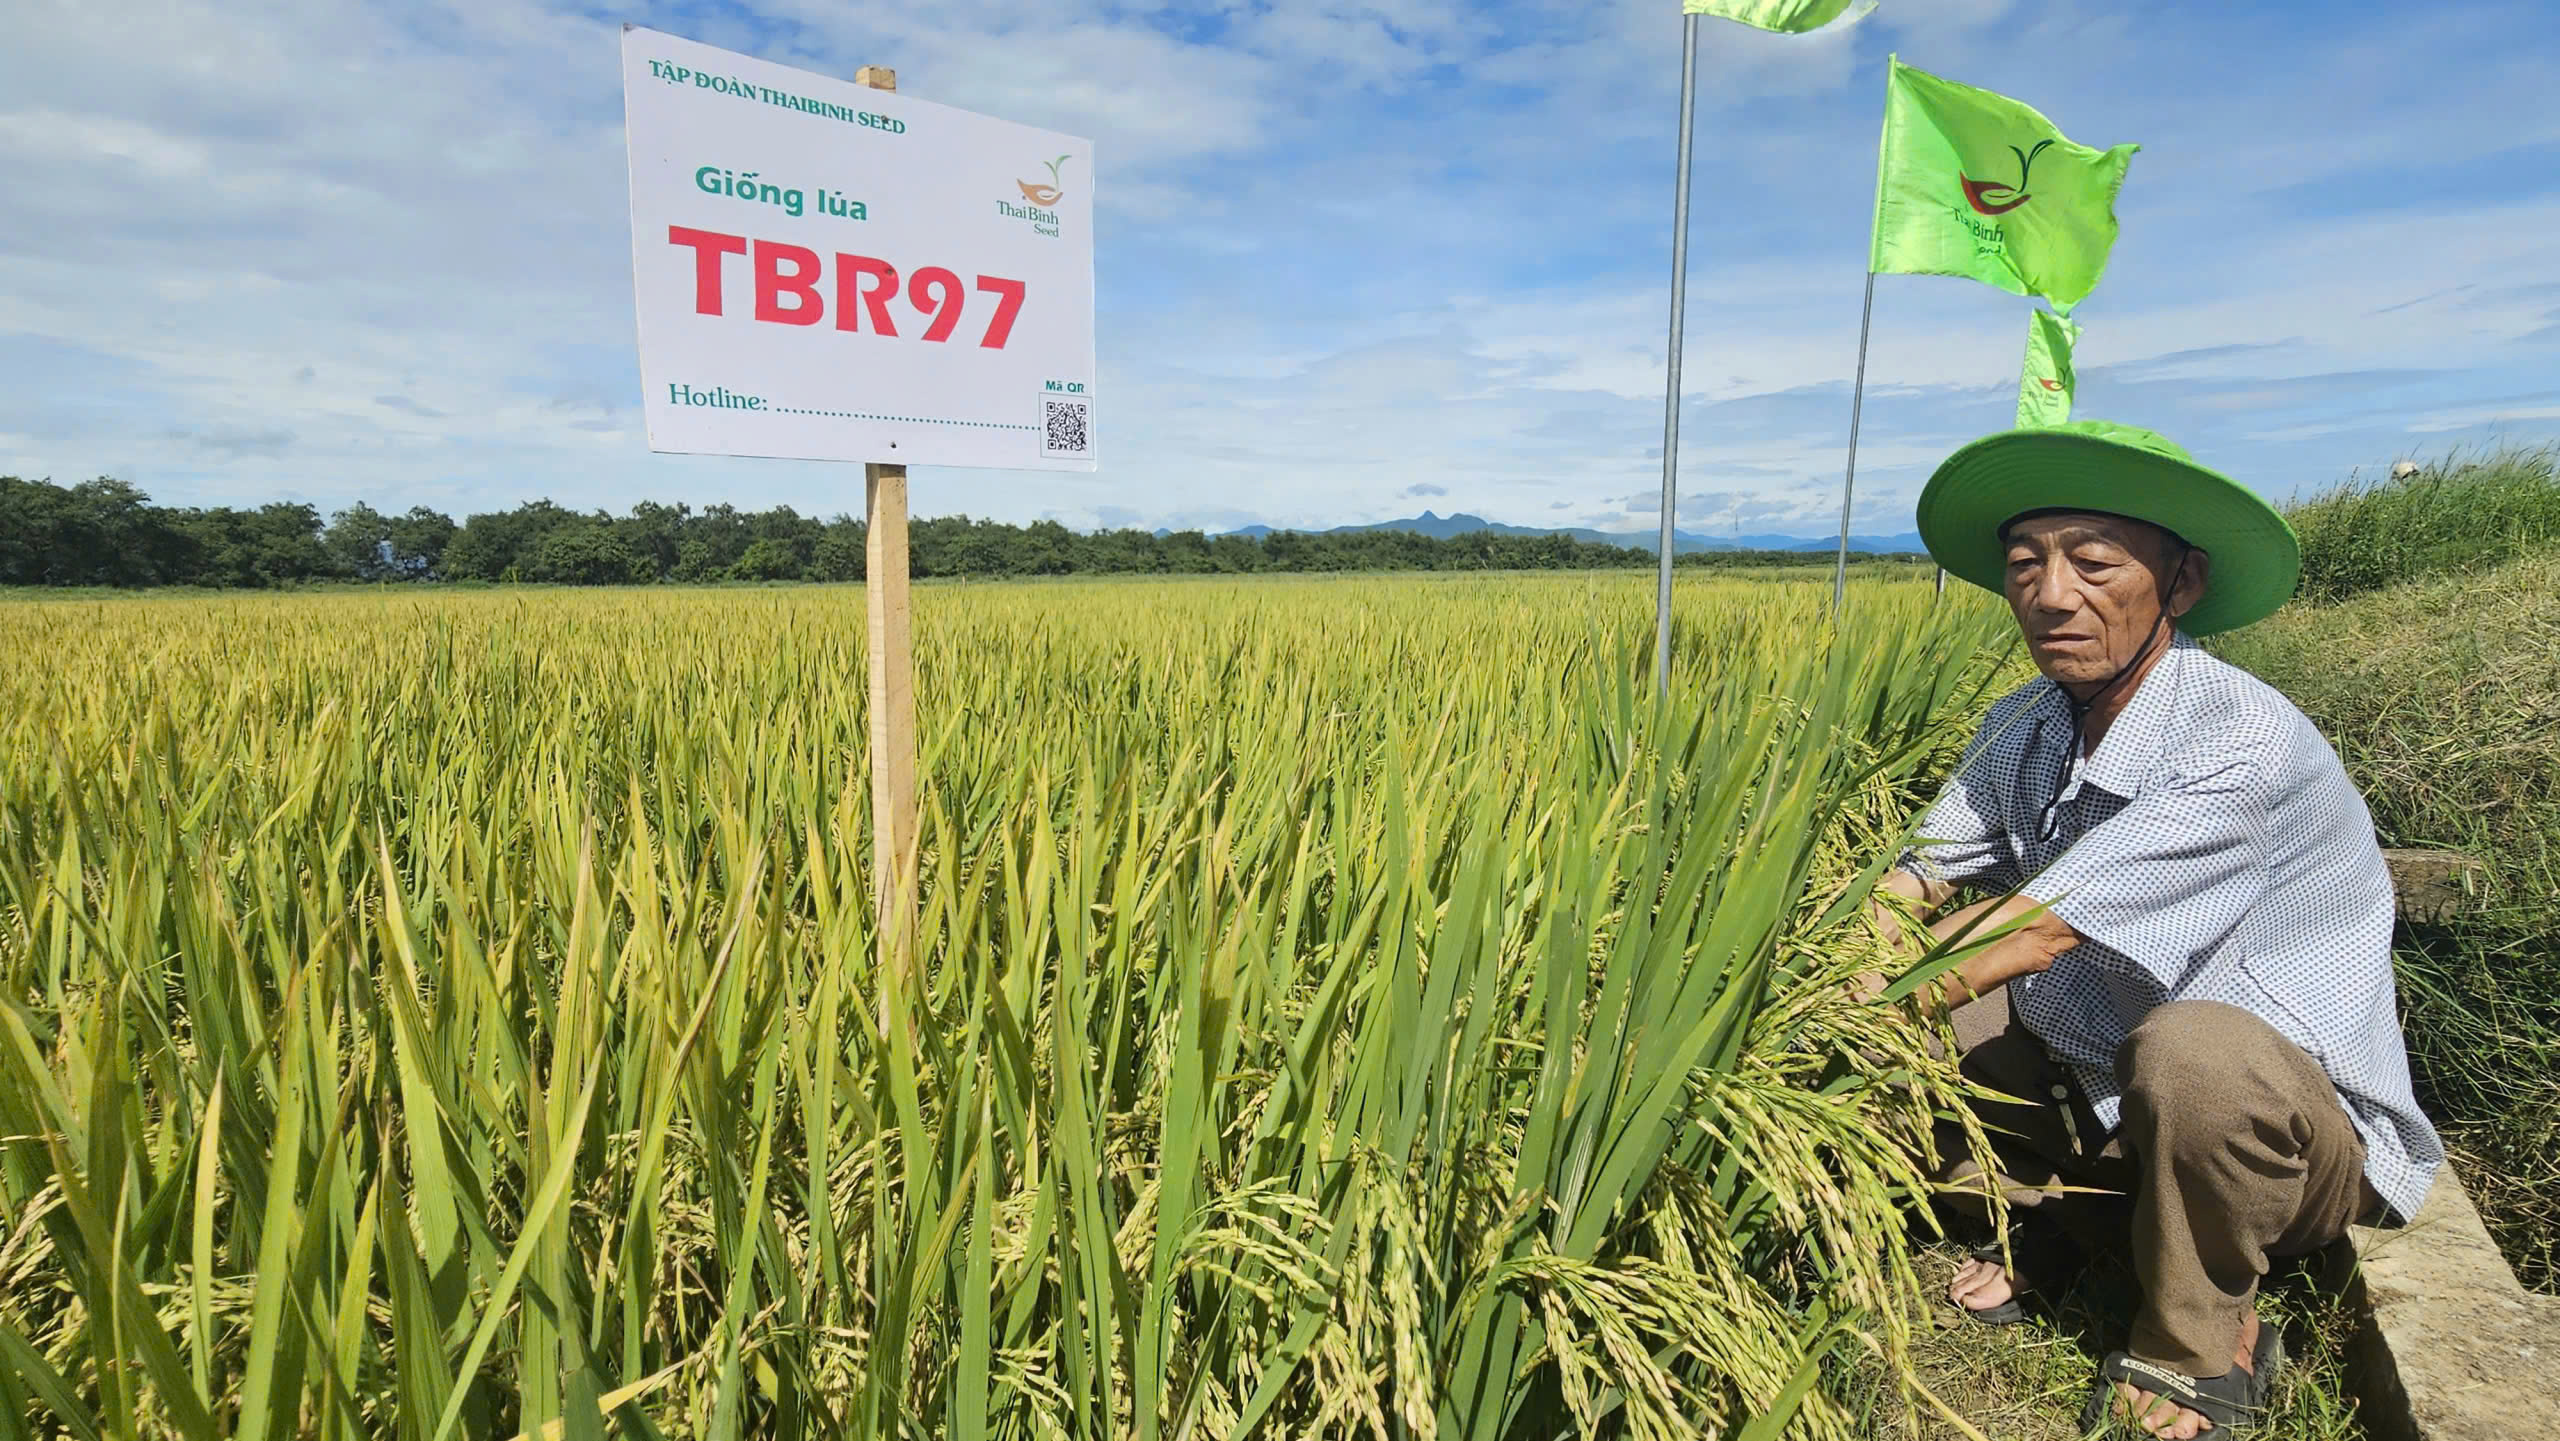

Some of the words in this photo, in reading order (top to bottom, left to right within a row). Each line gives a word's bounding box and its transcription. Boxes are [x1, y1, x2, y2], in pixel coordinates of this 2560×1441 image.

[648, 59, 691, 85] TẬP
[695, 71, 757, 100] ĐOÀN
[759, 87, 854, 123] THAIBINH
[857, 111, 906, 134] SEED
[695, 166, 804, 217] Giống
[817, 188, 867, 221] lúa
[1034, 223, 1059, 238] Seed
[669, 224, 1026, 350] TBR97
[1045, 380, 1063, 391] Mã
[1067, 382, 1085, 393] QR
